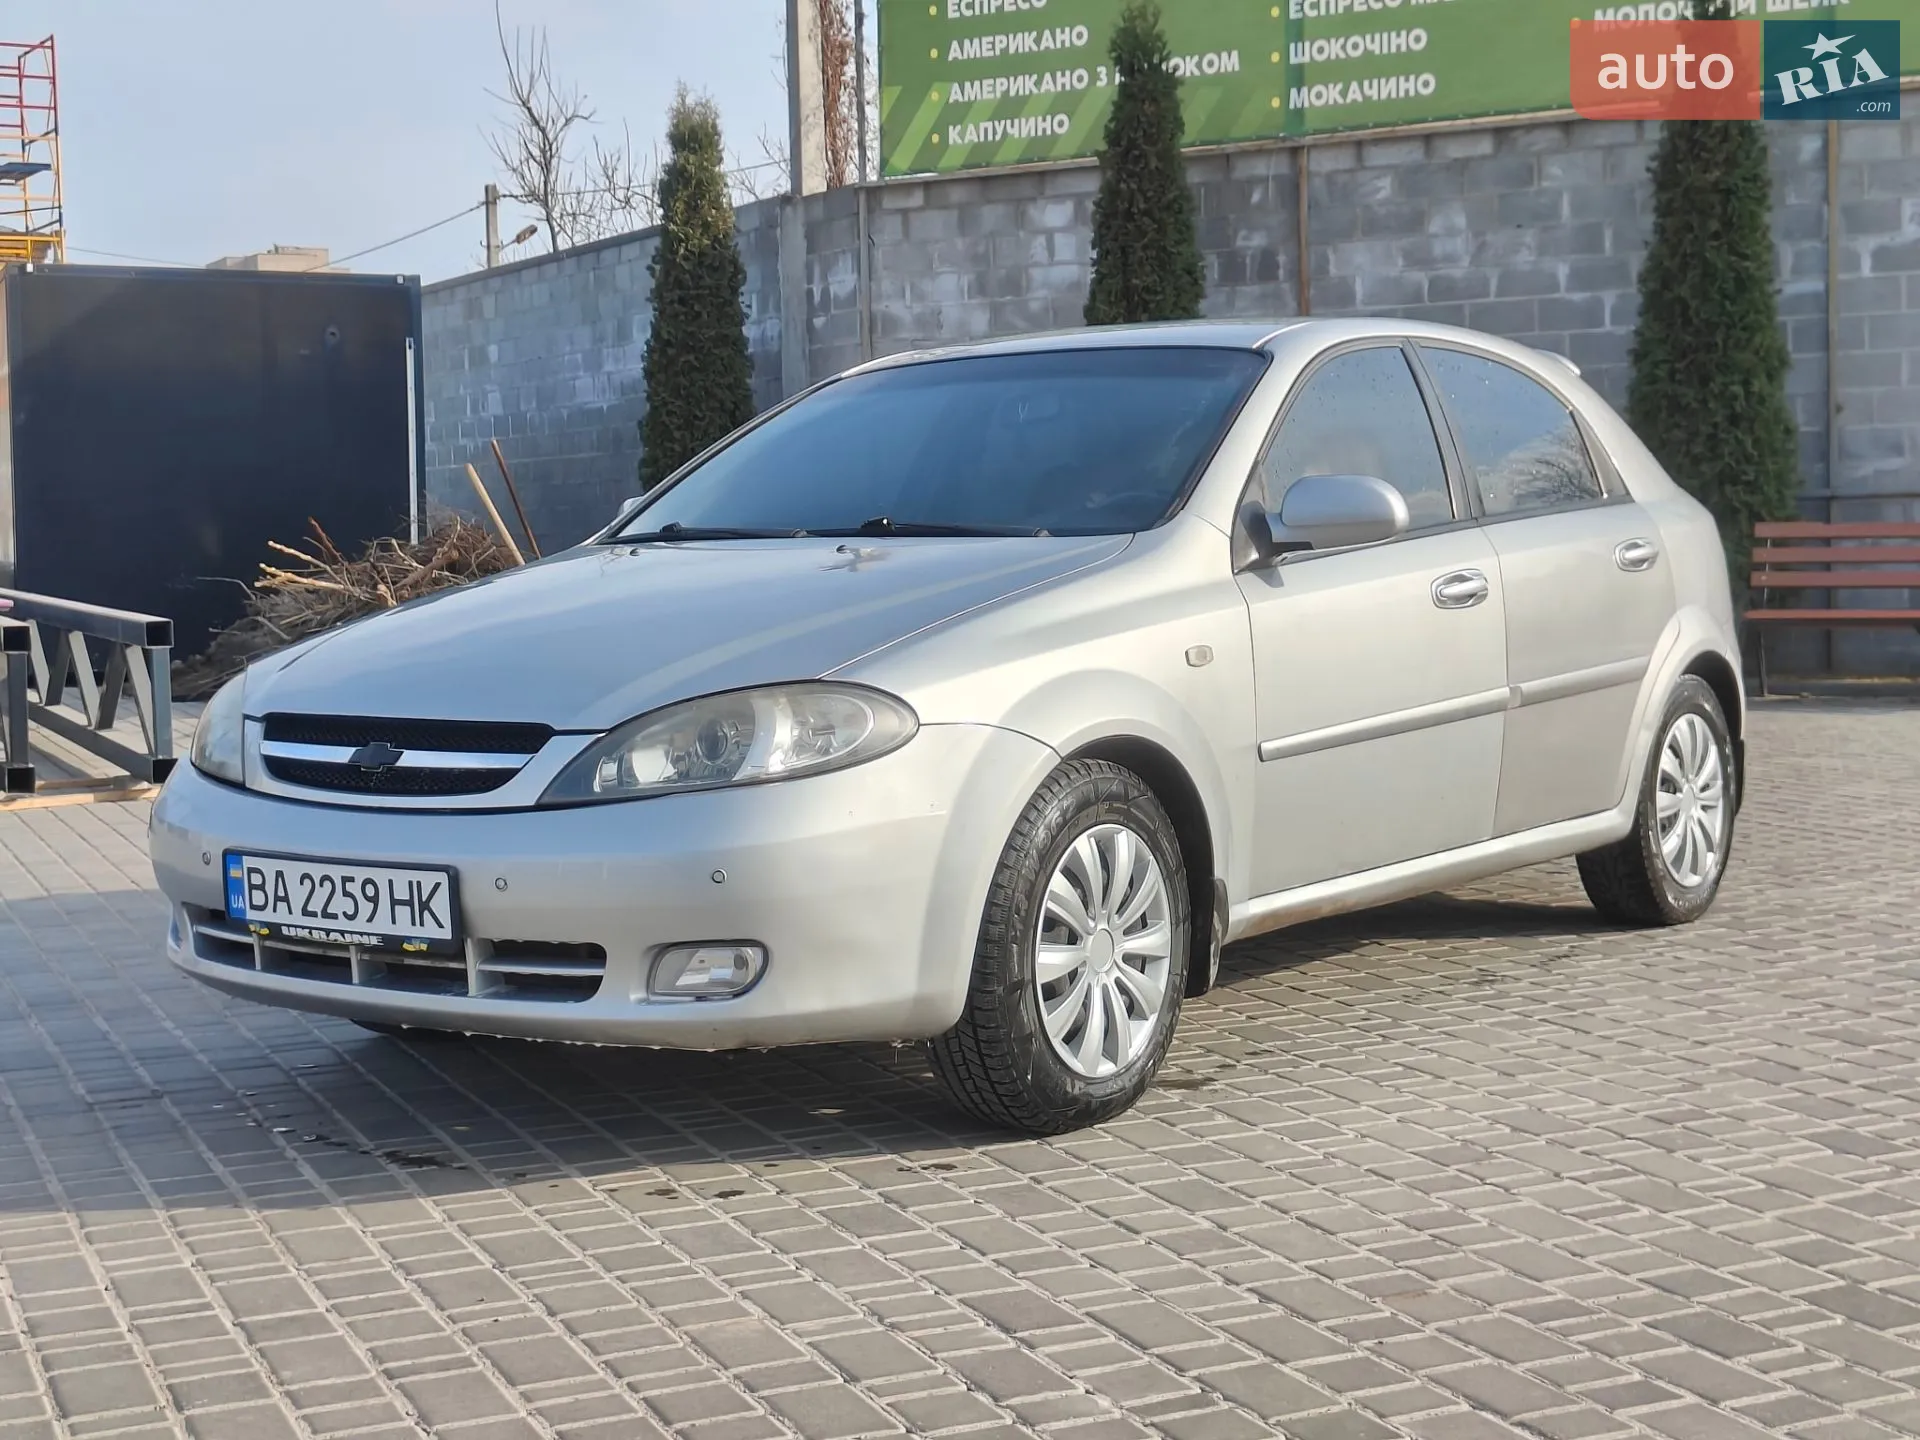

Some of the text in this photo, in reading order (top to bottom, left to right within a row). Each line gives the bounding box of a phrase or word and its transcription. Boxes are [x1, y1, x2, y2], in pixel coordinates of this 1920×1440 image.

[948, 24, 1089, 61] АМЕРИКАНО
[1289, 27, 1428, 65] ШОКОЧІНО
[948, 67, 1089, 104] АМЕРИКАНО
[1115, 50, 1240, 85] ОКОМ
[1289, 72, 1436, 110] МОКАЧИНО
[948, 113, 1070, 145] КАПУЧИНО
[231, 897, 245, 909] UA
[247, 866, 445, 928] BA 2259 HK
[281, 925, 384, 946] UKRAINE
